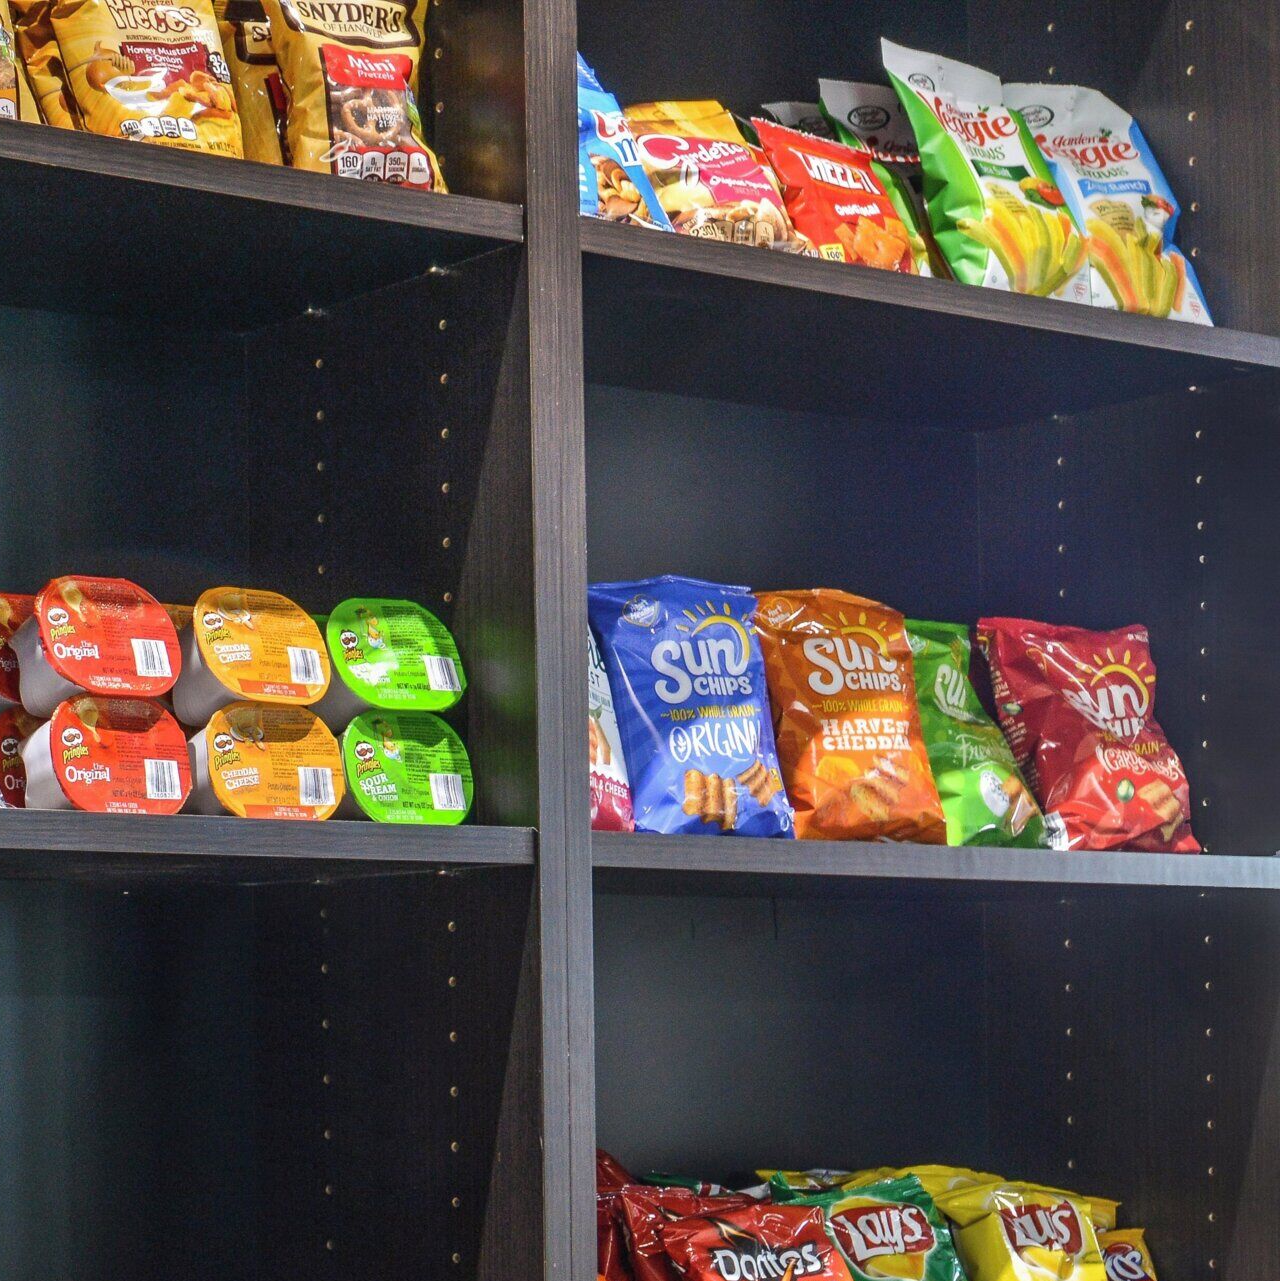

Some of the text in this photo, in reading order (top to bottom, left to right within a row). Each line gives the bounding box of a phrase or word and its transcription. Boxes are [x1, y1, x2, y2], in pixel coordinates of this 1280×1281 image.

[299, 0, 404, 33] SNYDER'S
[335, 24, 383, 39] HANOVER
[126, 45, 198, 55] Honey Mustard
[348, 54, 396, 73] Mini
[357, 70, 395, 81] Pretzels
[340, 155, 359, 169] 160
[50, 624, 76, 642] Pringles
[204, 628, 231, 645] Pringles
[53, 641, 100, 660] Original
[218, 651, 252, 664] CHEESE
[650, 639, 749, 704] Sun
[803, 637, 898, 696] Sun
[693, 674, 753, 696] CHIPS
[844, 671, 902, 692] CHIPS
[847, 700, 877, 712] WHOLE
[820, 718, 910, 737] HARVEST
[62, 745, 89, 764] Pringles
[214, 752, 240, 770] Pringles
[65, 764, 111, 783] Original
[221, 767, 260, 779] CHEDDAR
[356, 760, 382, 778] Pringles
[225, 776, 260, 790] CHEESE
[359, 773, 388, 787] SOUR
[364, 784, 396, 795] CREAM
[605, 782, 628, 798] CHEESE
[830, 1205, 924, 1261] Lay's
